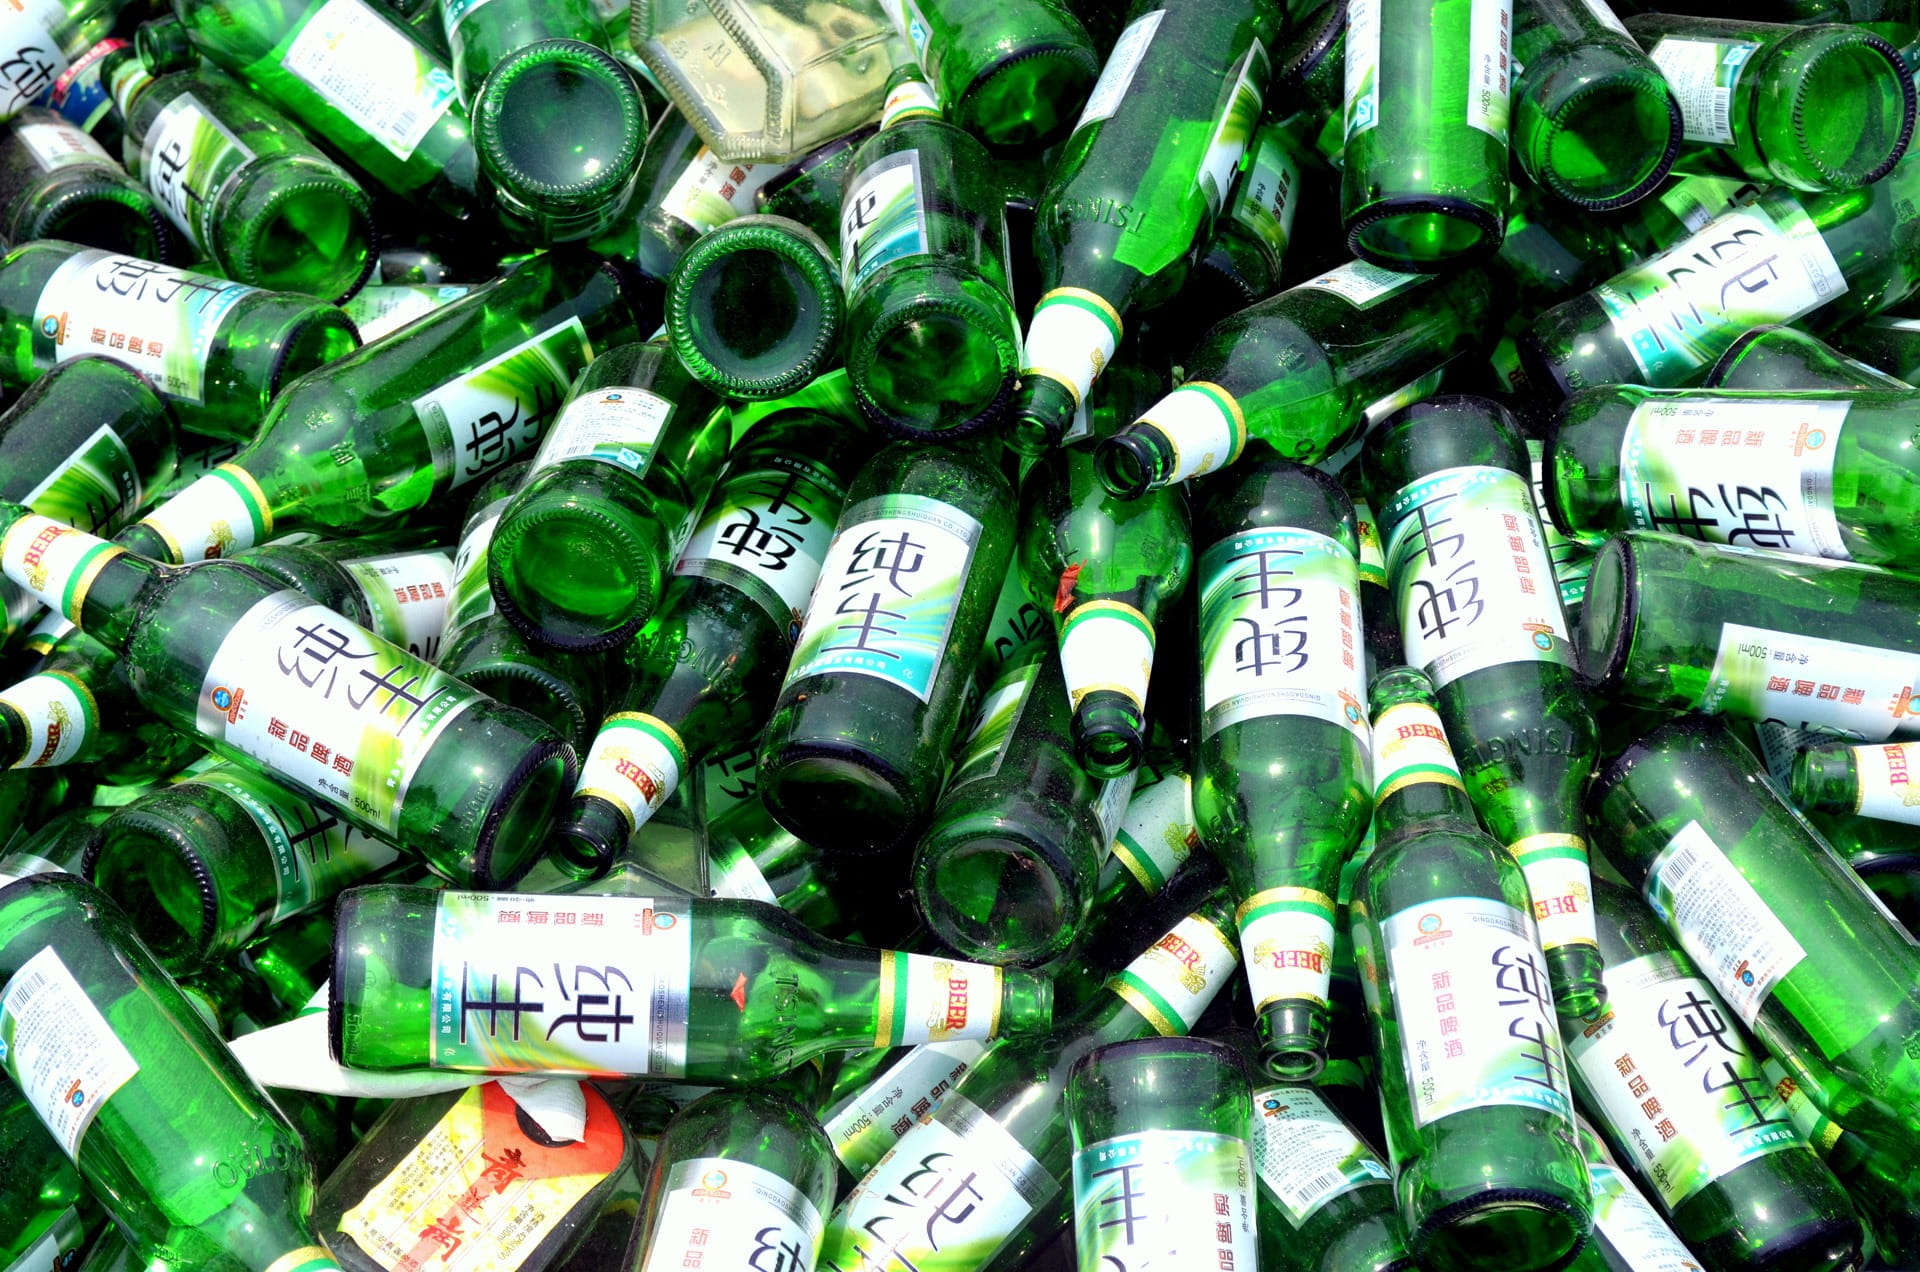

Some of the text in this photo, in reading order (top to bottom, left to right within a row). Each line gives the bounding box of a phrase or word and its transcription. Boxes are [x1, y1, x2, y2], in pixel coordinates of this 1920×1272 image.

[24, 524, 66, 567] BEER
[717, 473, 822, 571] 纯生
[820, 531, 926, 660] 纯生
[1393, 492, 1485, 641] 纯生
[1226, 549, 1309, 677] 纯生
[277, 622, 449, 738] 纯生
[1766, 675, 1866, 706] 新品啤酒
[266, 716, 354, 777] 新品啤酒
[1396, 723, 1445, 743] BEER
[614, 758, 657, 805] BEER
[1535, 894, 1580, 922] BEE
[1156, 932, 1200, 971] BEER
[1272, 950, 1323, 975] BEER
[460, 961, 635, 1045] 纯生
[946, 978, 968, 1032] BEER
[1492, 945, 1569, 1101] 纯生
[1613, 1052, 1679, 1144] 新品啤酒
[1657, 991, 1793, 1138] 纯生
[683, 1227, 711, 1269] 新品
[1213, 1192, 1235, 1272] 品啤酒
